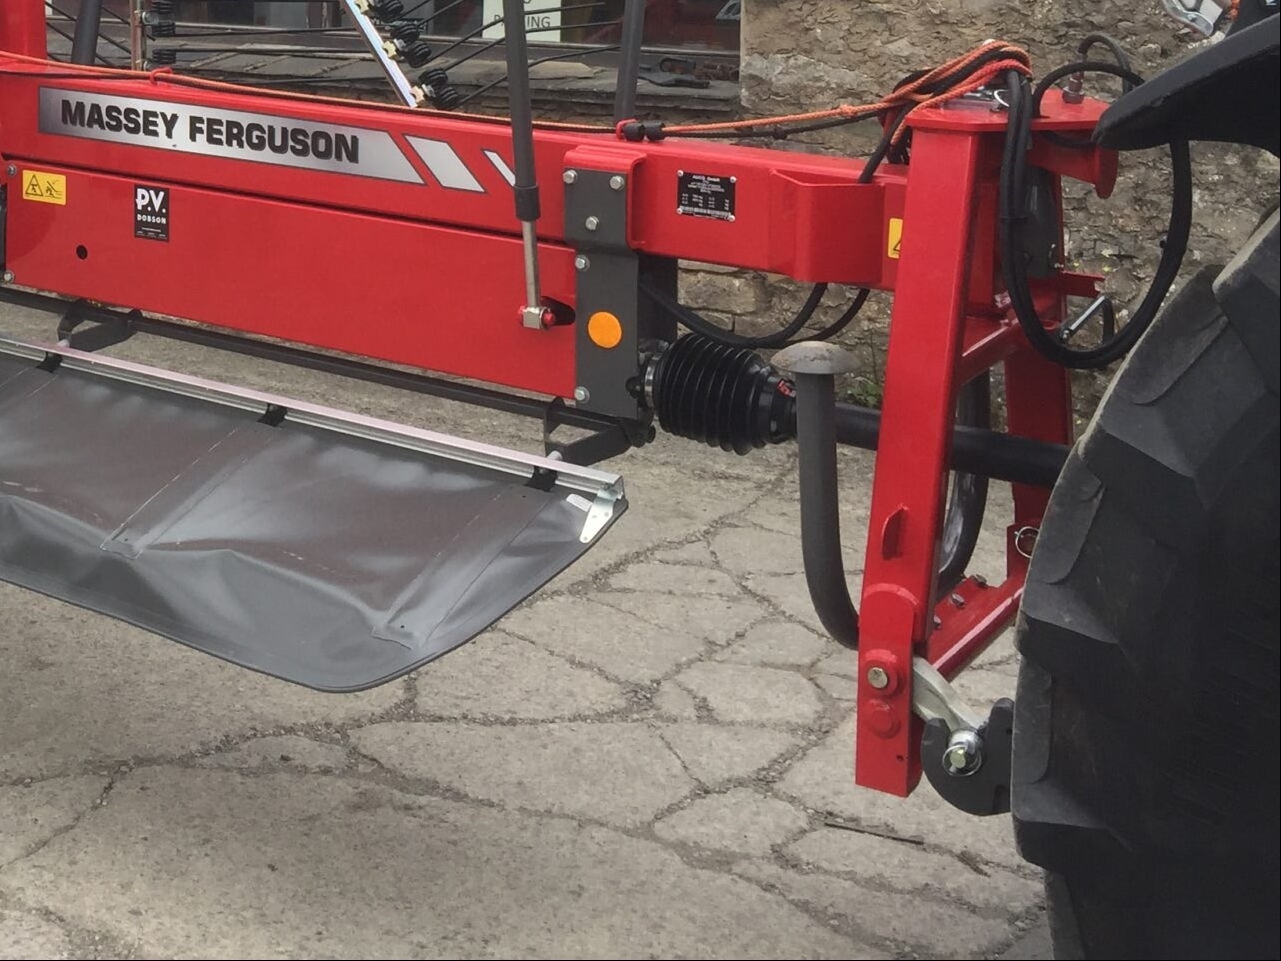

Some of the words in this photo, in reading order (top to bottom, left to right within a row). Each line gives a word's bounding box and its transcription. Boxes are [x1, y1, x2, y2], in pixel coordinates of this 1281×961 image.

[61, 99, 179, 139] MASSEY
[188, 115, 359, 164] FERGUSON
[137, 214, 167, 225] DOBSON
